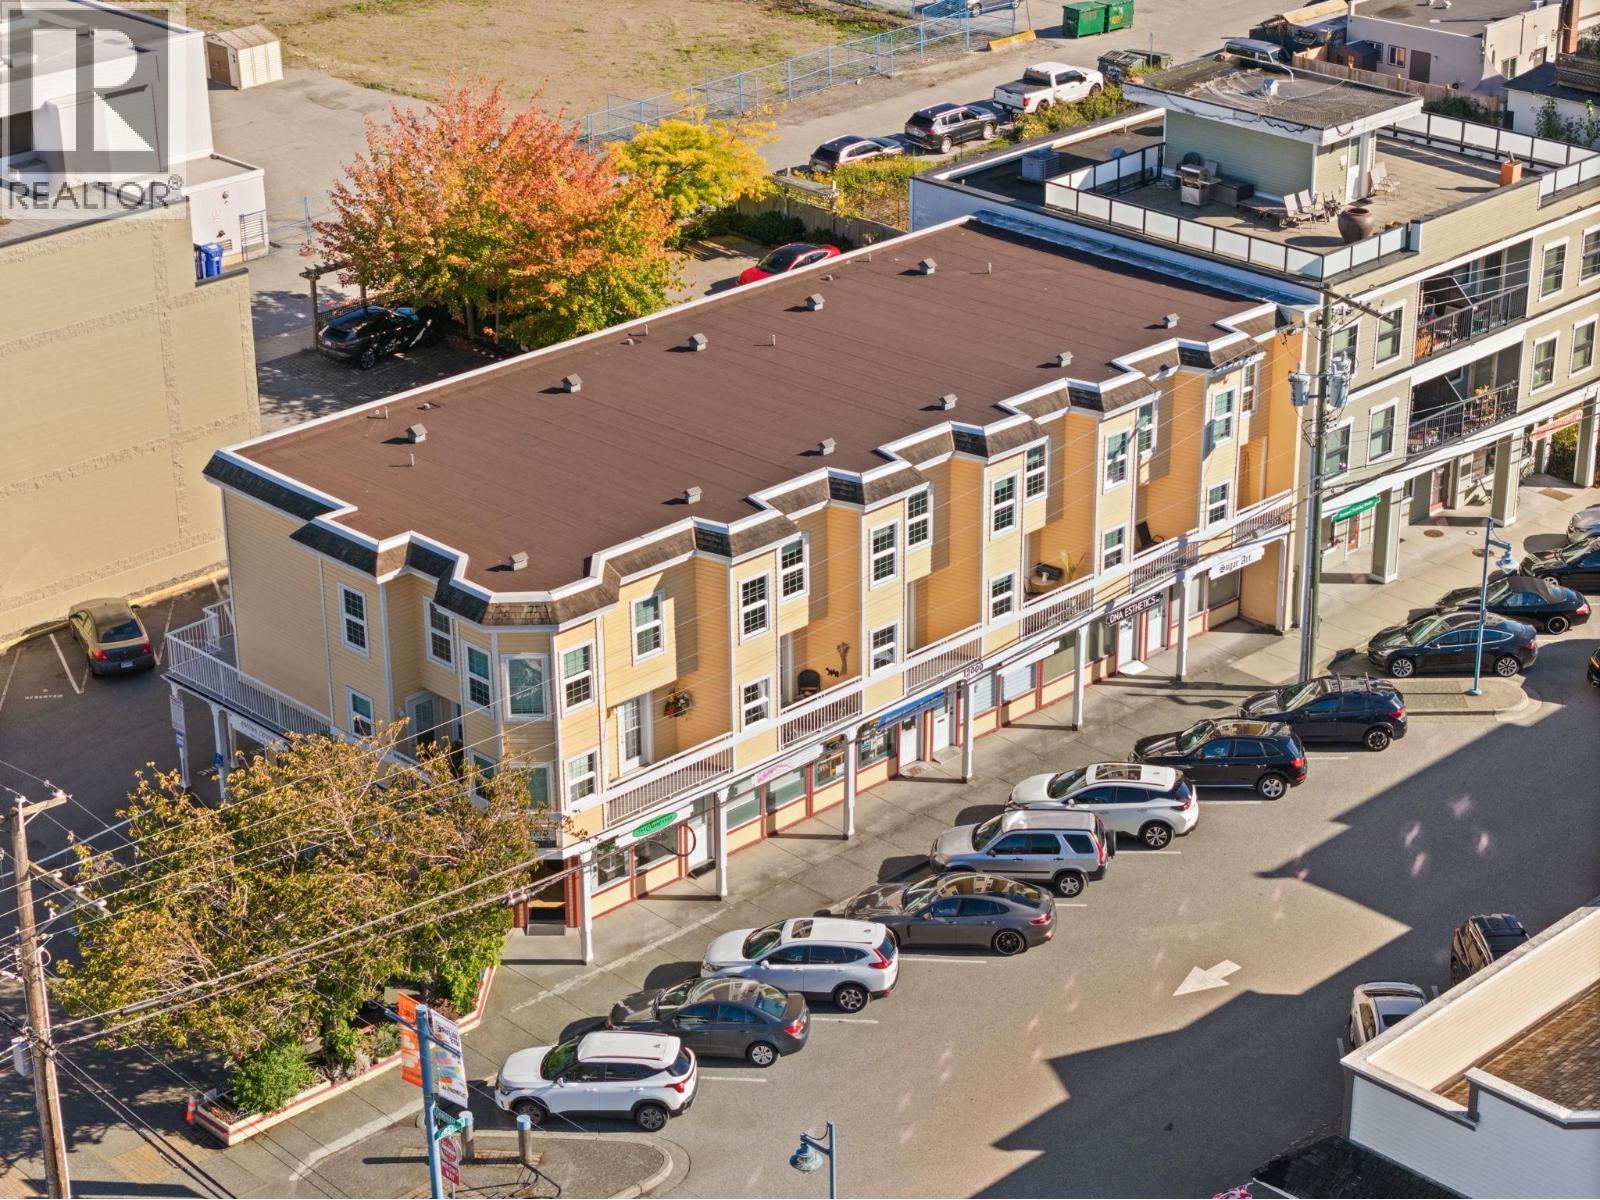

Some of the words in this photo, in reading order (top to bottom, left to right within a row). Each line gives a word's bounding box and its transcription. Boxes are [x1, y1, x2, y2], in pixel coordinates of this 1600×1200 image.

[1219, 560, 1239, 573] Sugar
[1240, 554, 1251, 565] Art
[1109, 610, 1124, 624] DNA
[1124, 596, 1156, 616] ESTHETICS
